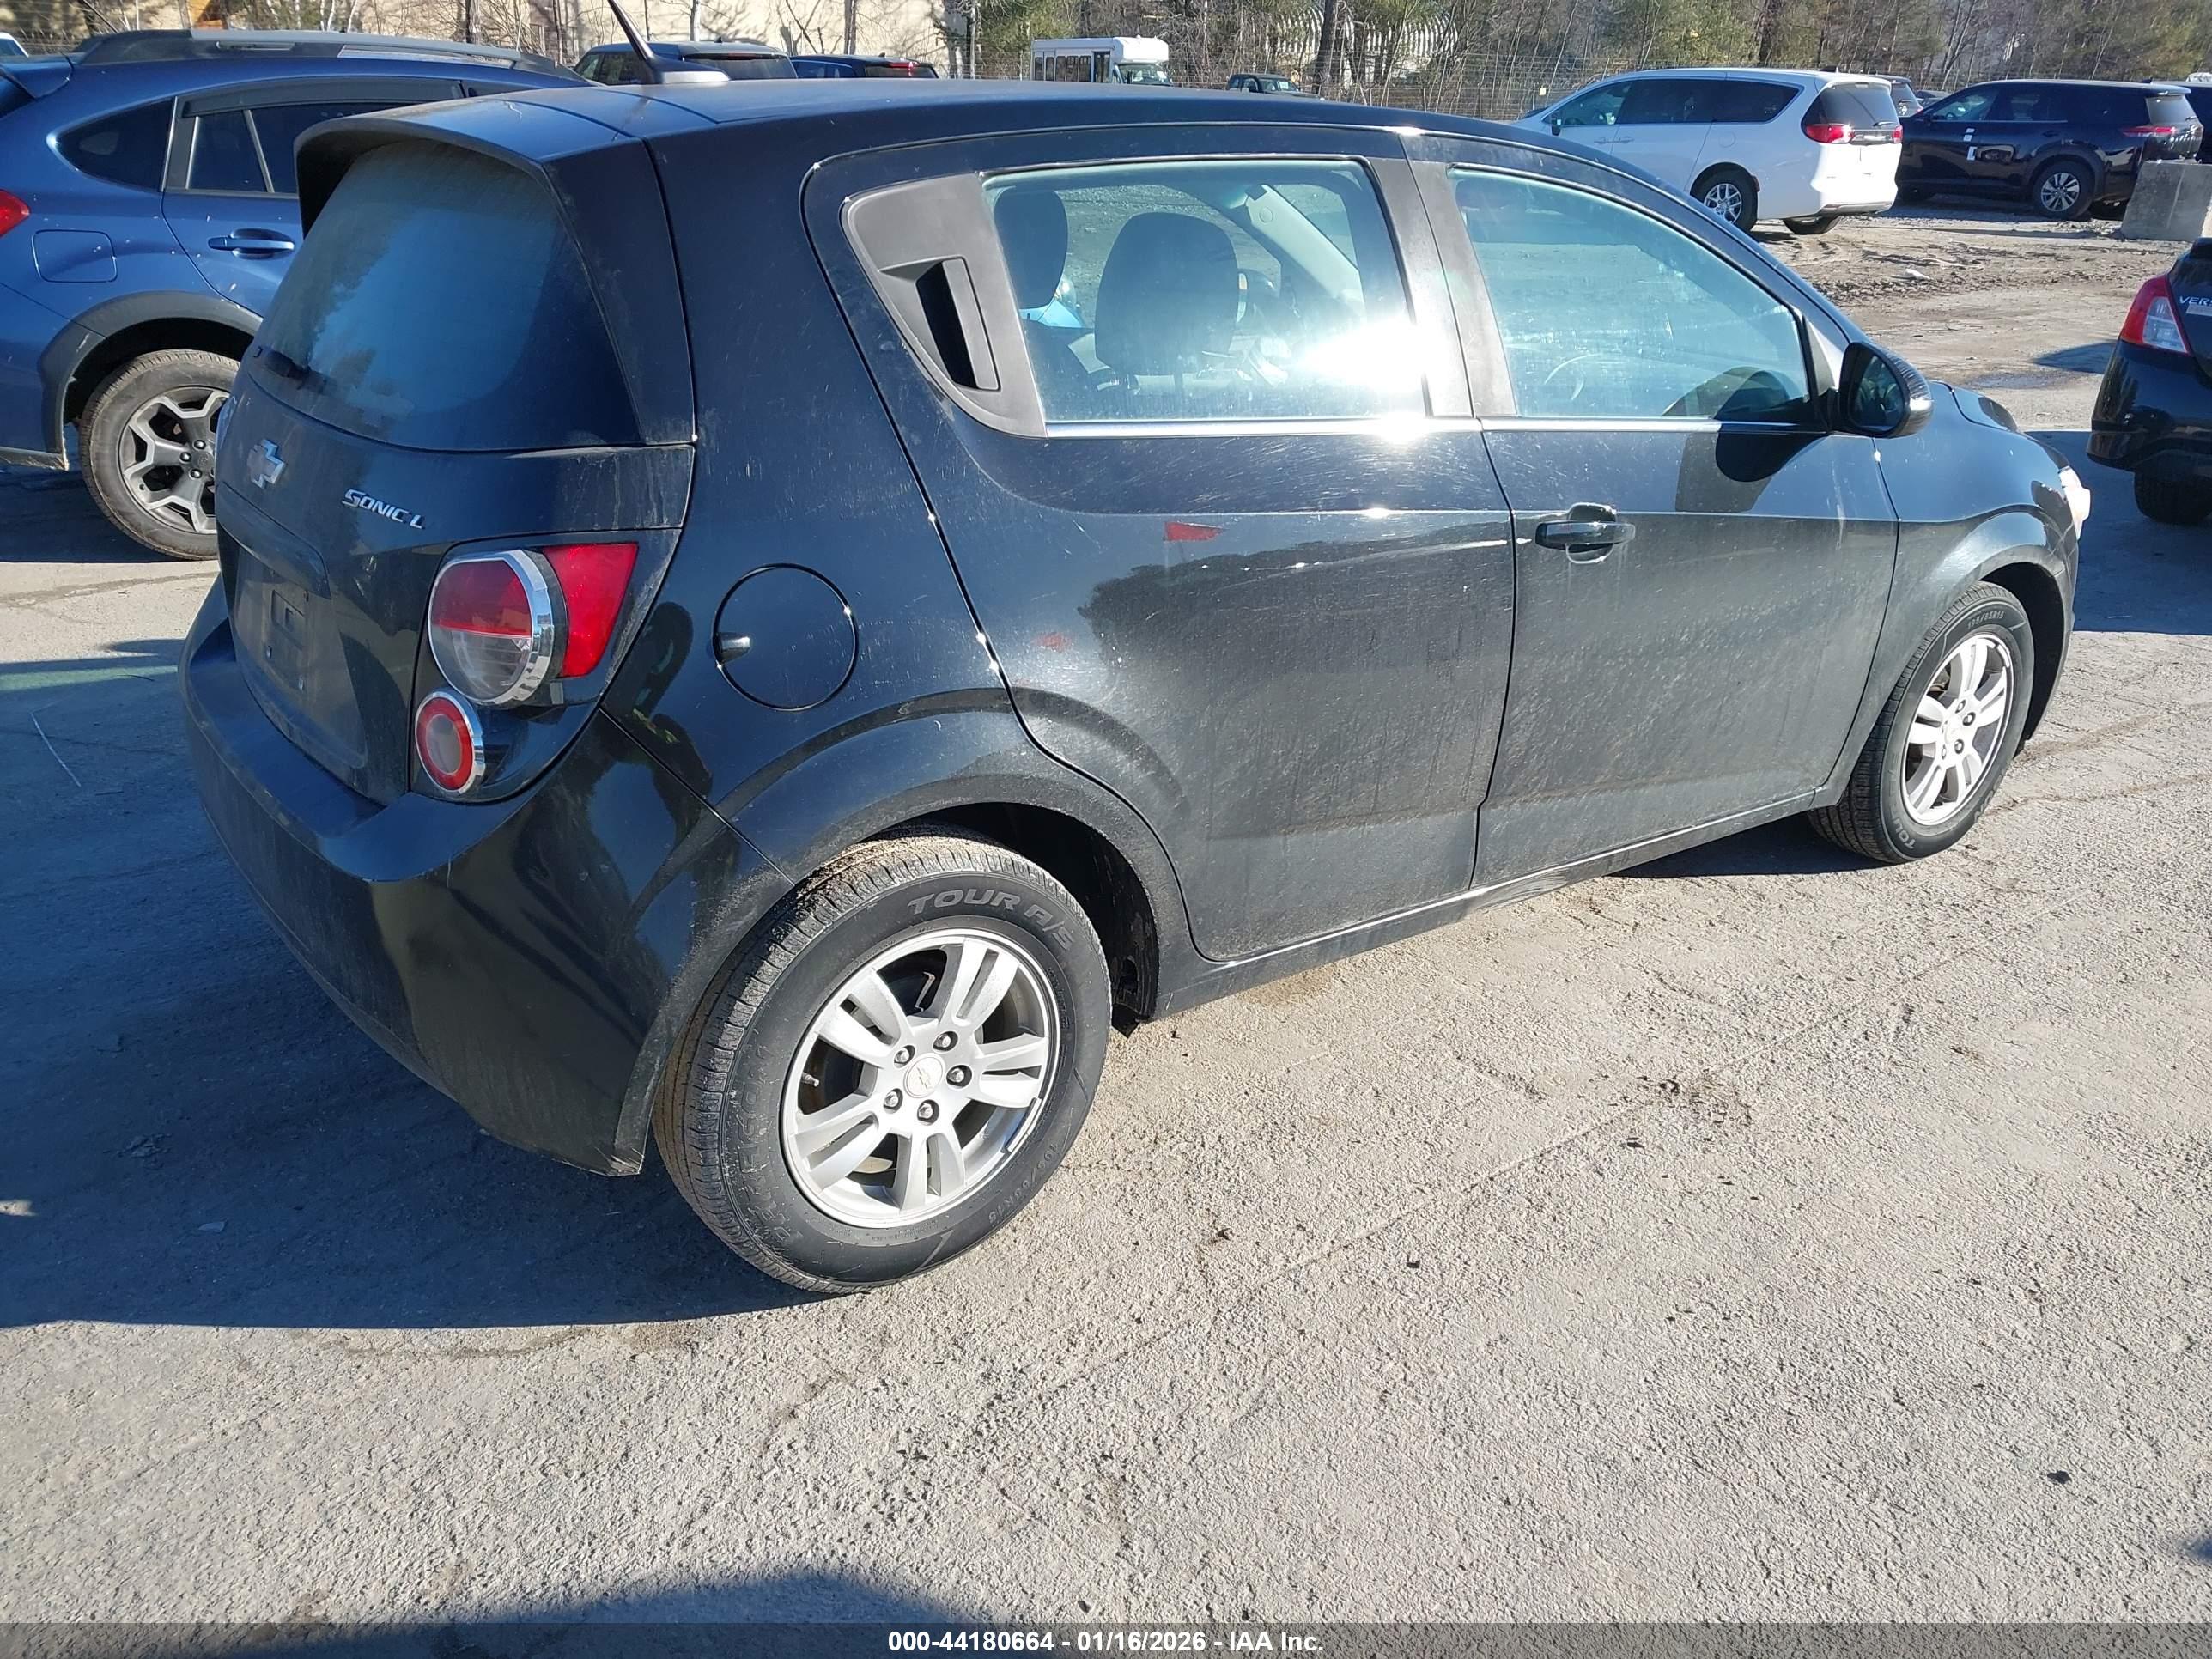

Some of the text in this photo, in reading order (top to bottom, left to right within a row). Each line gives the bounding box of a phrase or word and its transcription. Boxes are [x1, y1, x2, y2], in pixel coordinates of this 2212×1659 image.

[2179, 296, 2212, 306] VER
[342, 489, 410, 523] SONIC
[907, 889, 1074, 951] TOUR A/S
